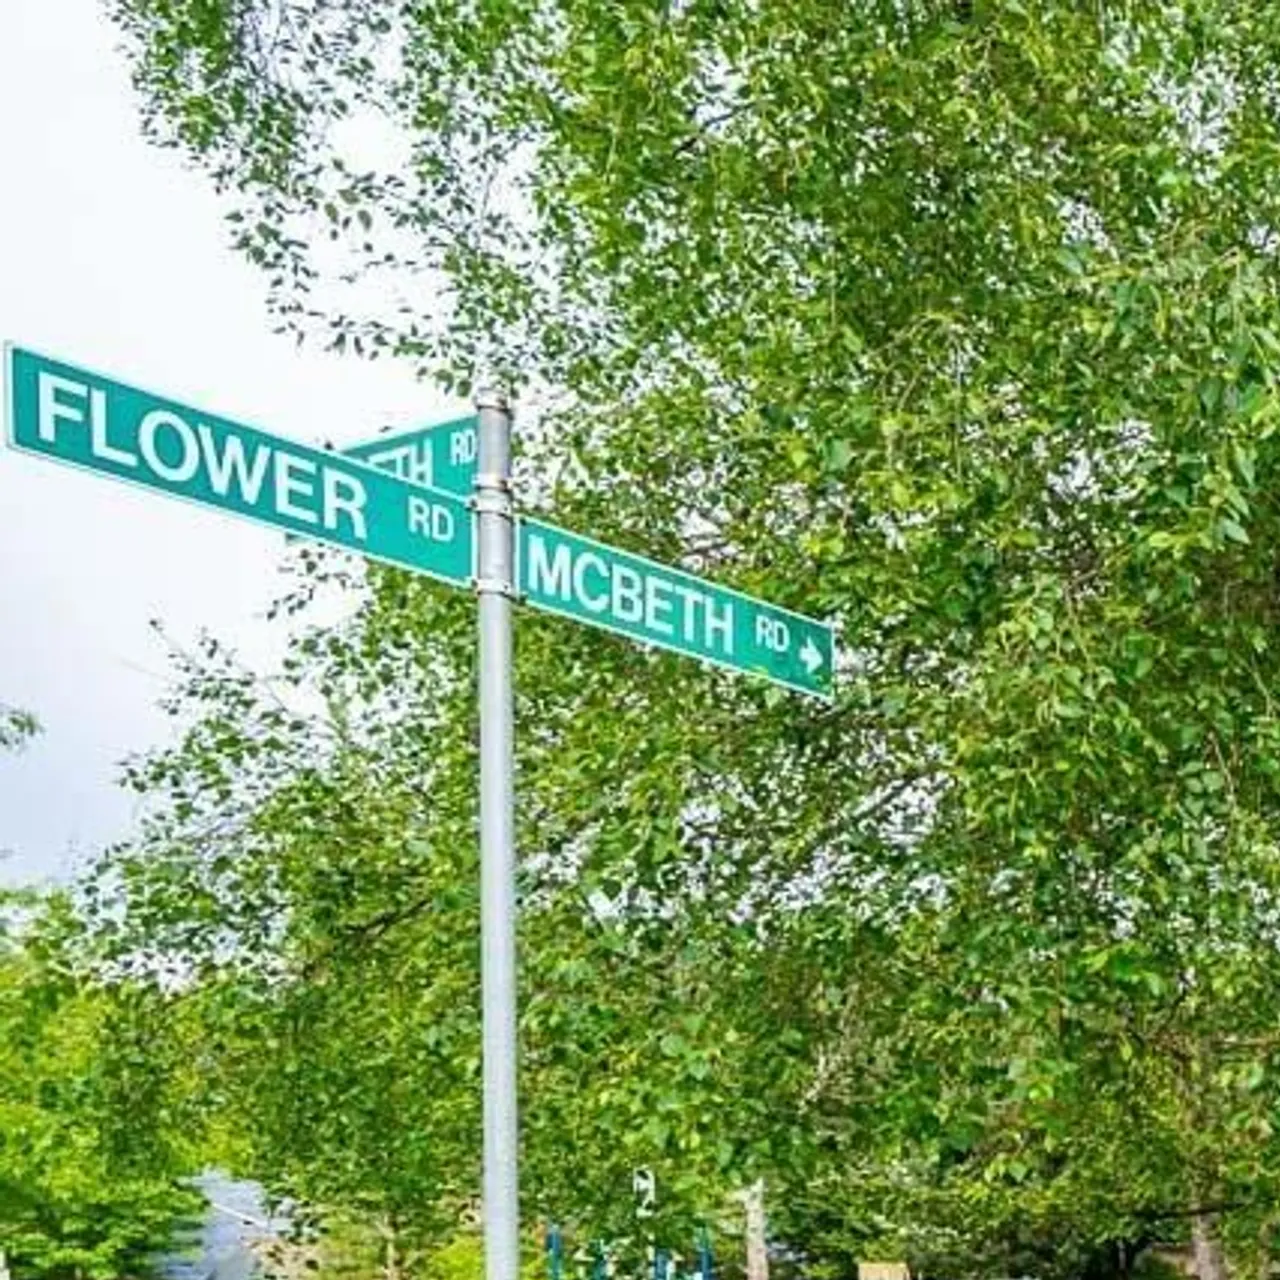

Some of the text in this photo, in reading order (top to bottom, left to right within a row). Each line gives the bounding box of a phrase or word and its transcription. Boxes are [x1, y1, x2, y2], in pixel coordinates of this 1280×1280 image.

[36, 371, 455, 542] FLOWER RD
[451, 428, 476, 466] RD
[527, 533, 790, 654] MCBETH RD
